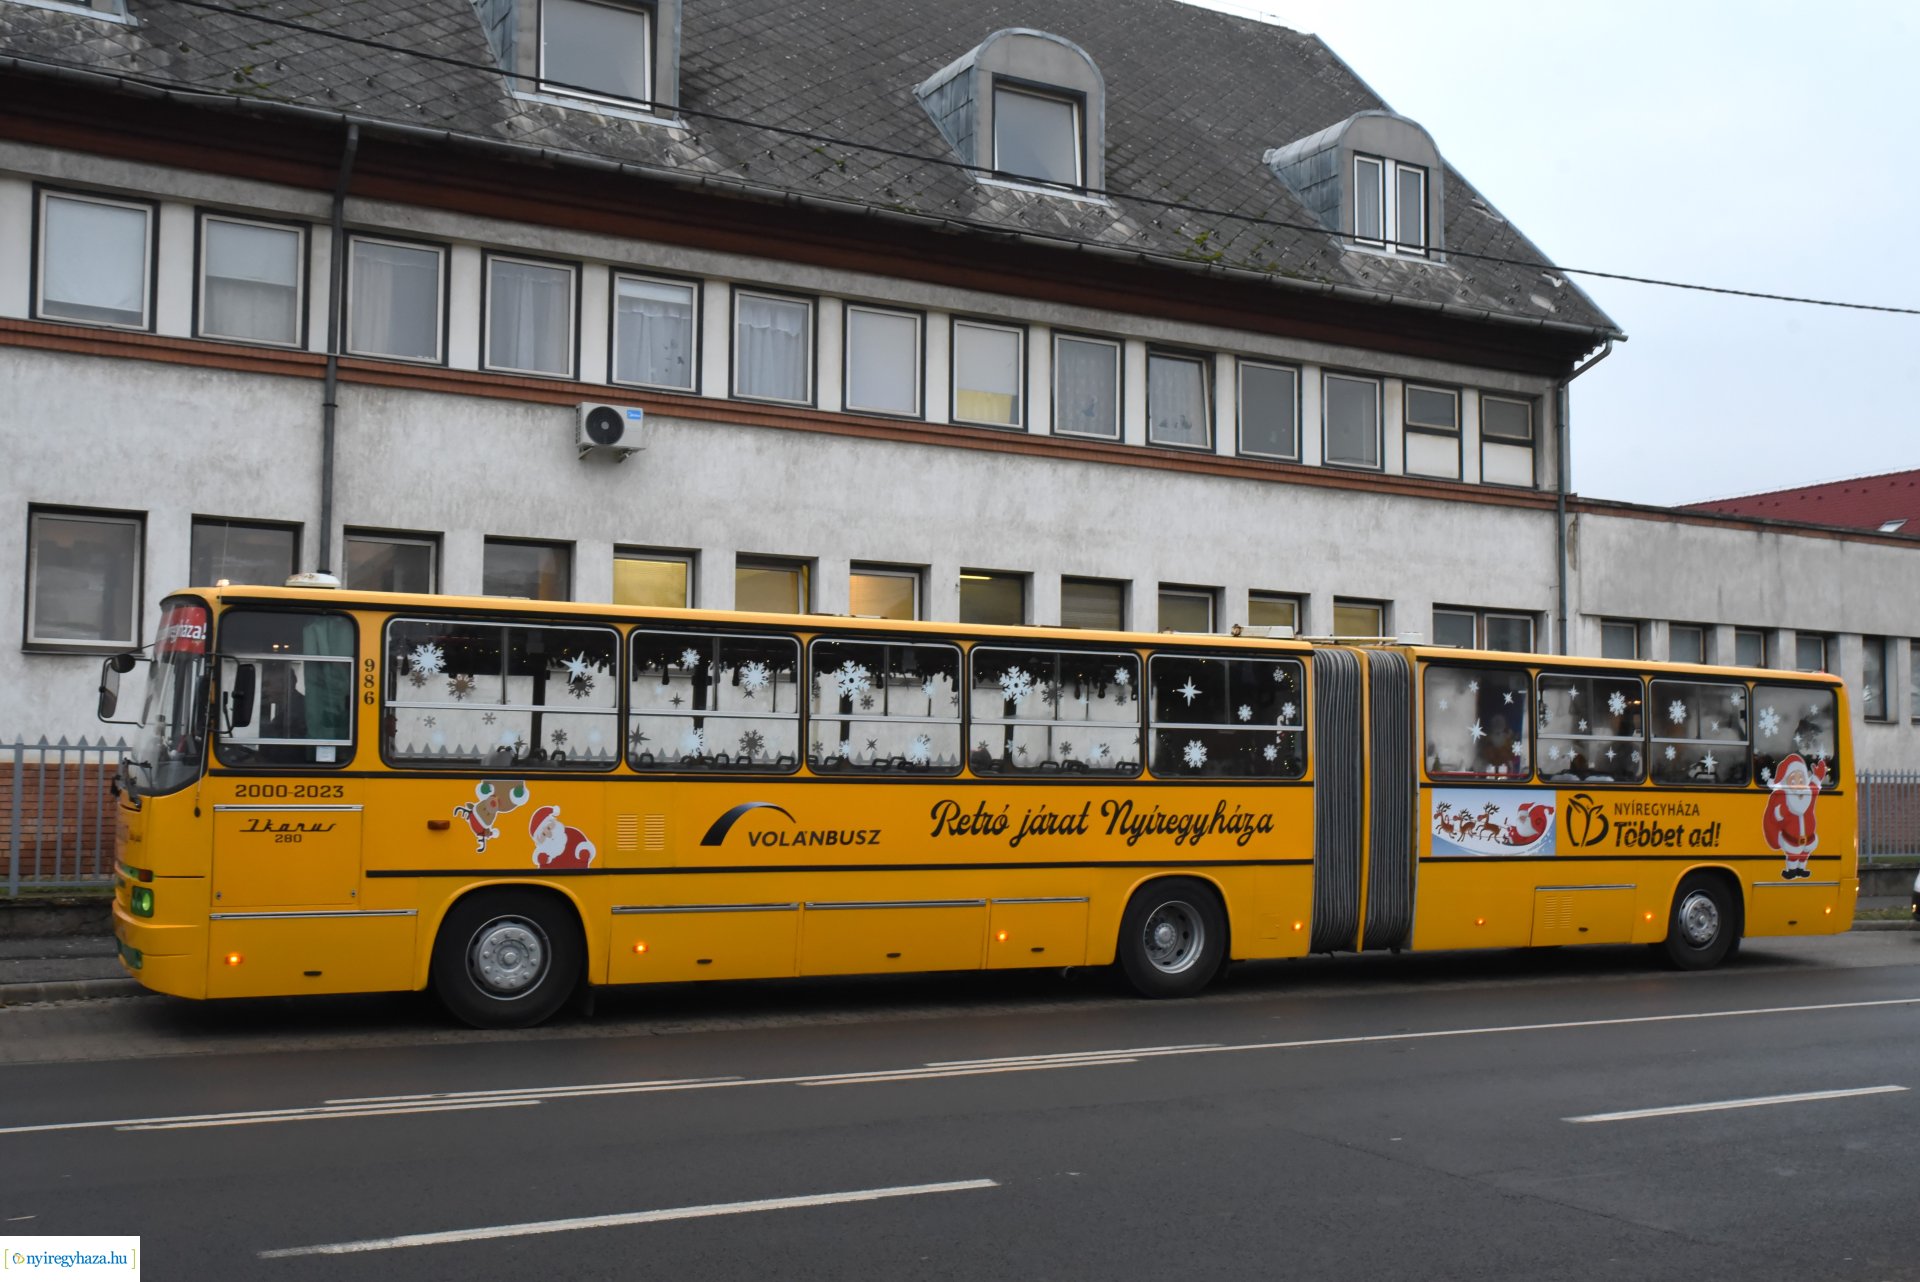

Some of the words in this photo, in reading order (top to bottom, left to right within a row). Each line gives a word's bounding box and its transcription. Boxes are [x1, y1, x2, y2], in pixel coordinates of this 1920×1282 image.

[364, 658, 375, 705] 986
[235, 784, 344, 798] 2000-2023
[1614, 800, 1700, 817] NYÍREGYHÁZA
[239, 818, 336, 833] Ikarus
[930, 799, 1010, 838] Retró
[1009, 800, 1092, 848] járat
[1100, 799, 1275, 847] Nyíregyháza
[274, 833, 303, 844] 280
[748, 829, 882, 847] VOLÁNBUSZ
[1613, 820, 1685, 848] Többet
[1688, 821, 1722, 848] ad!
